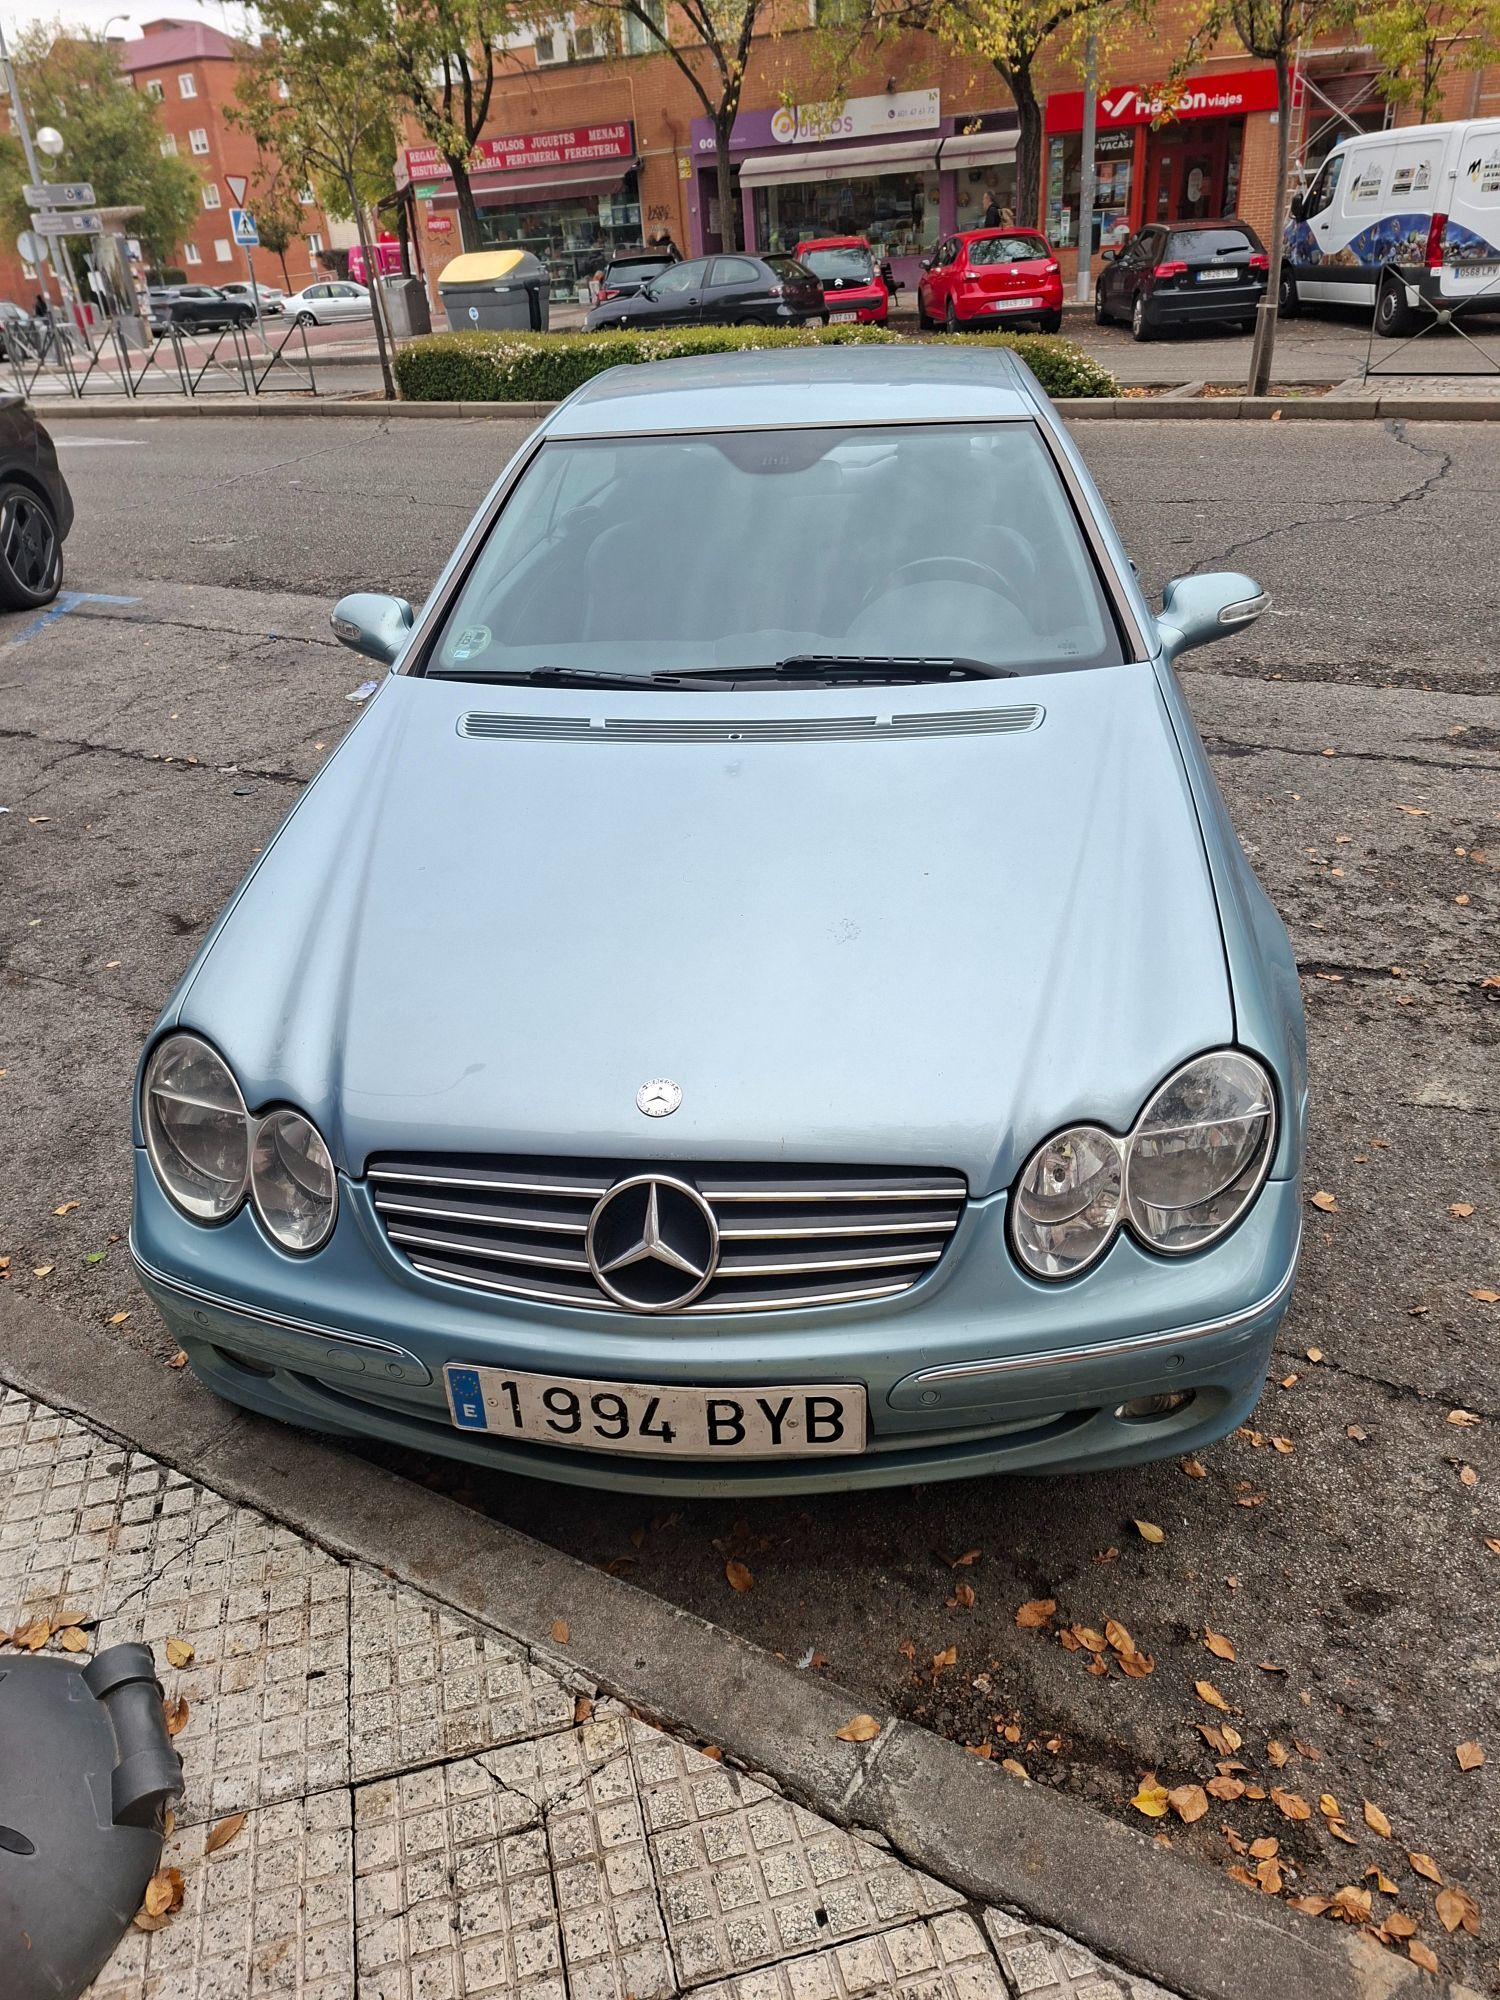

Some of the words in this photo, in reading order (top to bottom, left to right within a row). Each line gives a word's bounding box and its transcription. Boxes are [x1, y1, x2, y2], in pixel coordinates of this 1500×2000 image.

[1135, 91, 1207, 115] haón
[1208, 93, 1243, 108] viajes
[492, 138, 525, 153] BOLSOS
[531, 132, 576, 149] JUGUETES
[588, 126, 625, 141] MENAJE
[506, 151, 560, 166] PERFUMERIA
[565, 143, 621, 160] FERRETERIA
[463, 1403, 478, 1418] E
[500, 1380, 677, 1444] 1994
[705, 1396, 845, 1446] BYB
